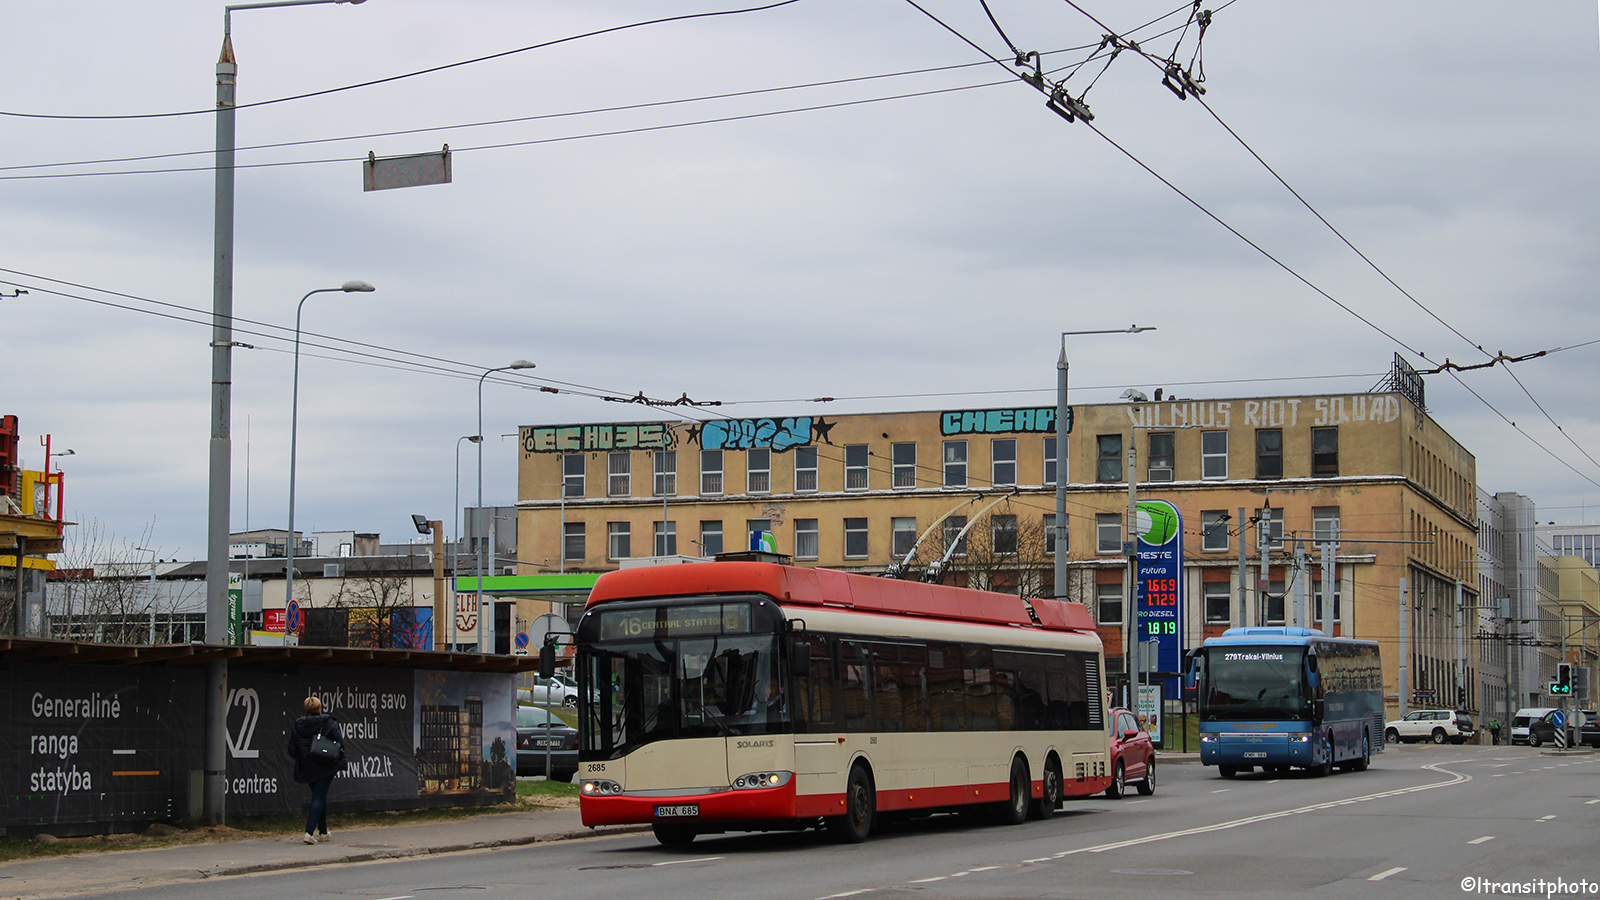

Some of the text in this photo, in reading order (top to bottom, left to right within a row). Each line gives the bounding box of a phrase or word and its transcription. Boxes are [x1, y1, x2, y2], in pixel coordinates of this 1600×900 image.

[1127, 401, 1231, 429] VILNIUS
[1244, 399, 1301, 427] RIOT
[1315, 395, 1400, 425] SQUAD
[1141, 567, 1167, 575] Futura
[619, 616, 725, 636] 16 CENTRAL STATION
[31, 692, 121, 718] Generalinė
[347, 686, 377, 714] biurą
[381, 693, 407, 710] savo
[338, 716, 378, 740] verslui
[30, 735, 79, 760] ranga
[736, 740, 775, 748] SOLARIS
[587, 763, 606, 773] 2685
[30, 764, 92, 796] statyba
[232, 773, 278, 794] centras
[659, 806, 698, 816] BNA 685
